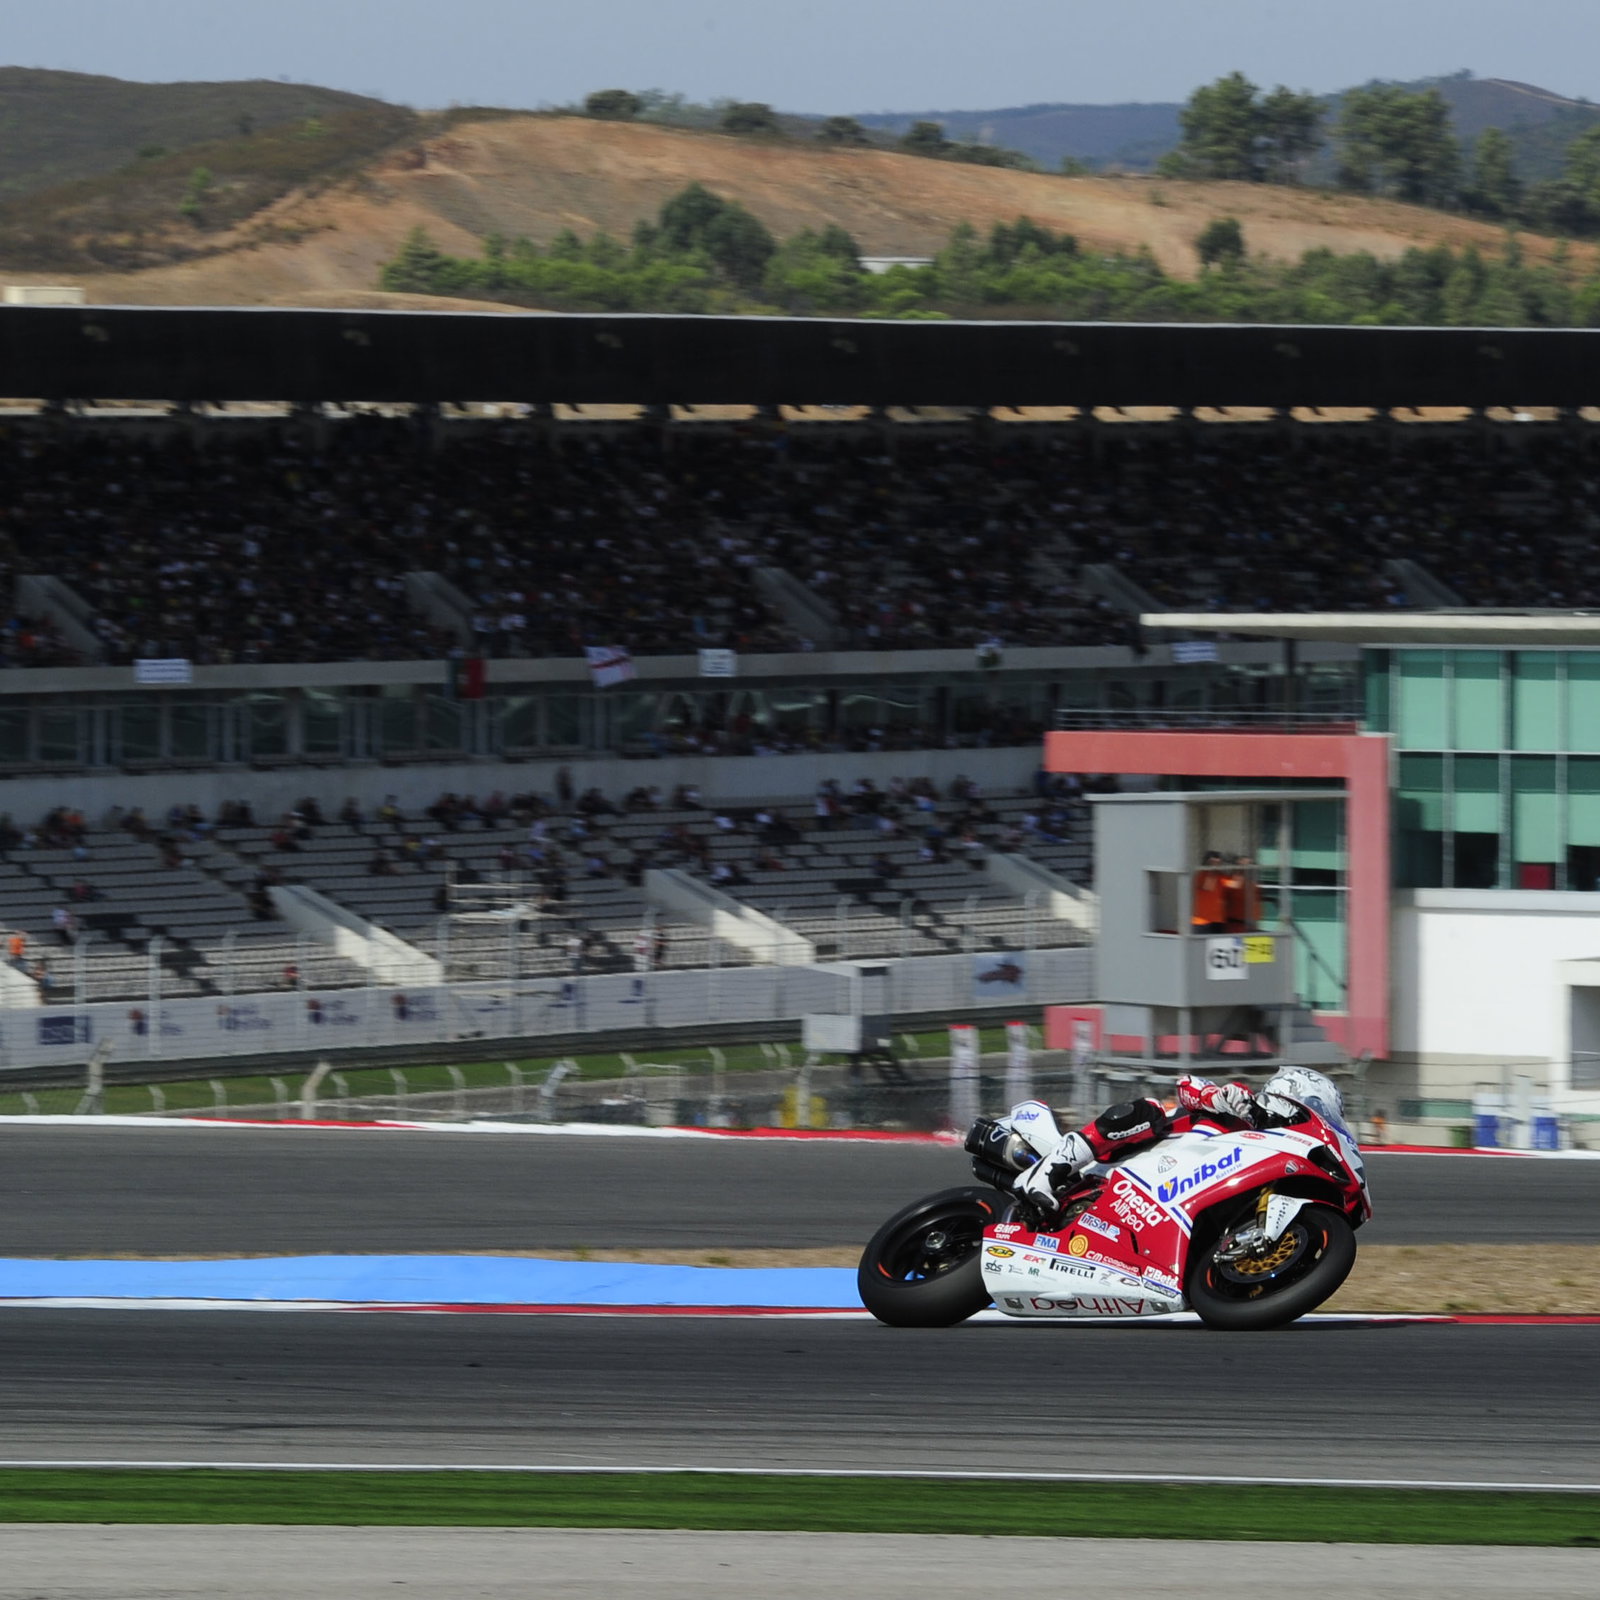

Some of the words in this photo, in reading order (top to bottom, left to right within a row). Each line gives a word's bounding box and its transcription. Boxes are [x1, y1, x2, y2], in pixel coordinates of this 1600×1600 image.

[1158, 1147, 1242, 1203] Unibat
[1109, 1199, 1145, 1233] Althea
[994, 1223, 1021, 1235] BMP
[1036, 1235, 1057, 1249] FMA
[1049, 1258, 1096, 1279] PIRELLI
[1029, 1297, 1145, 1314] Althea
